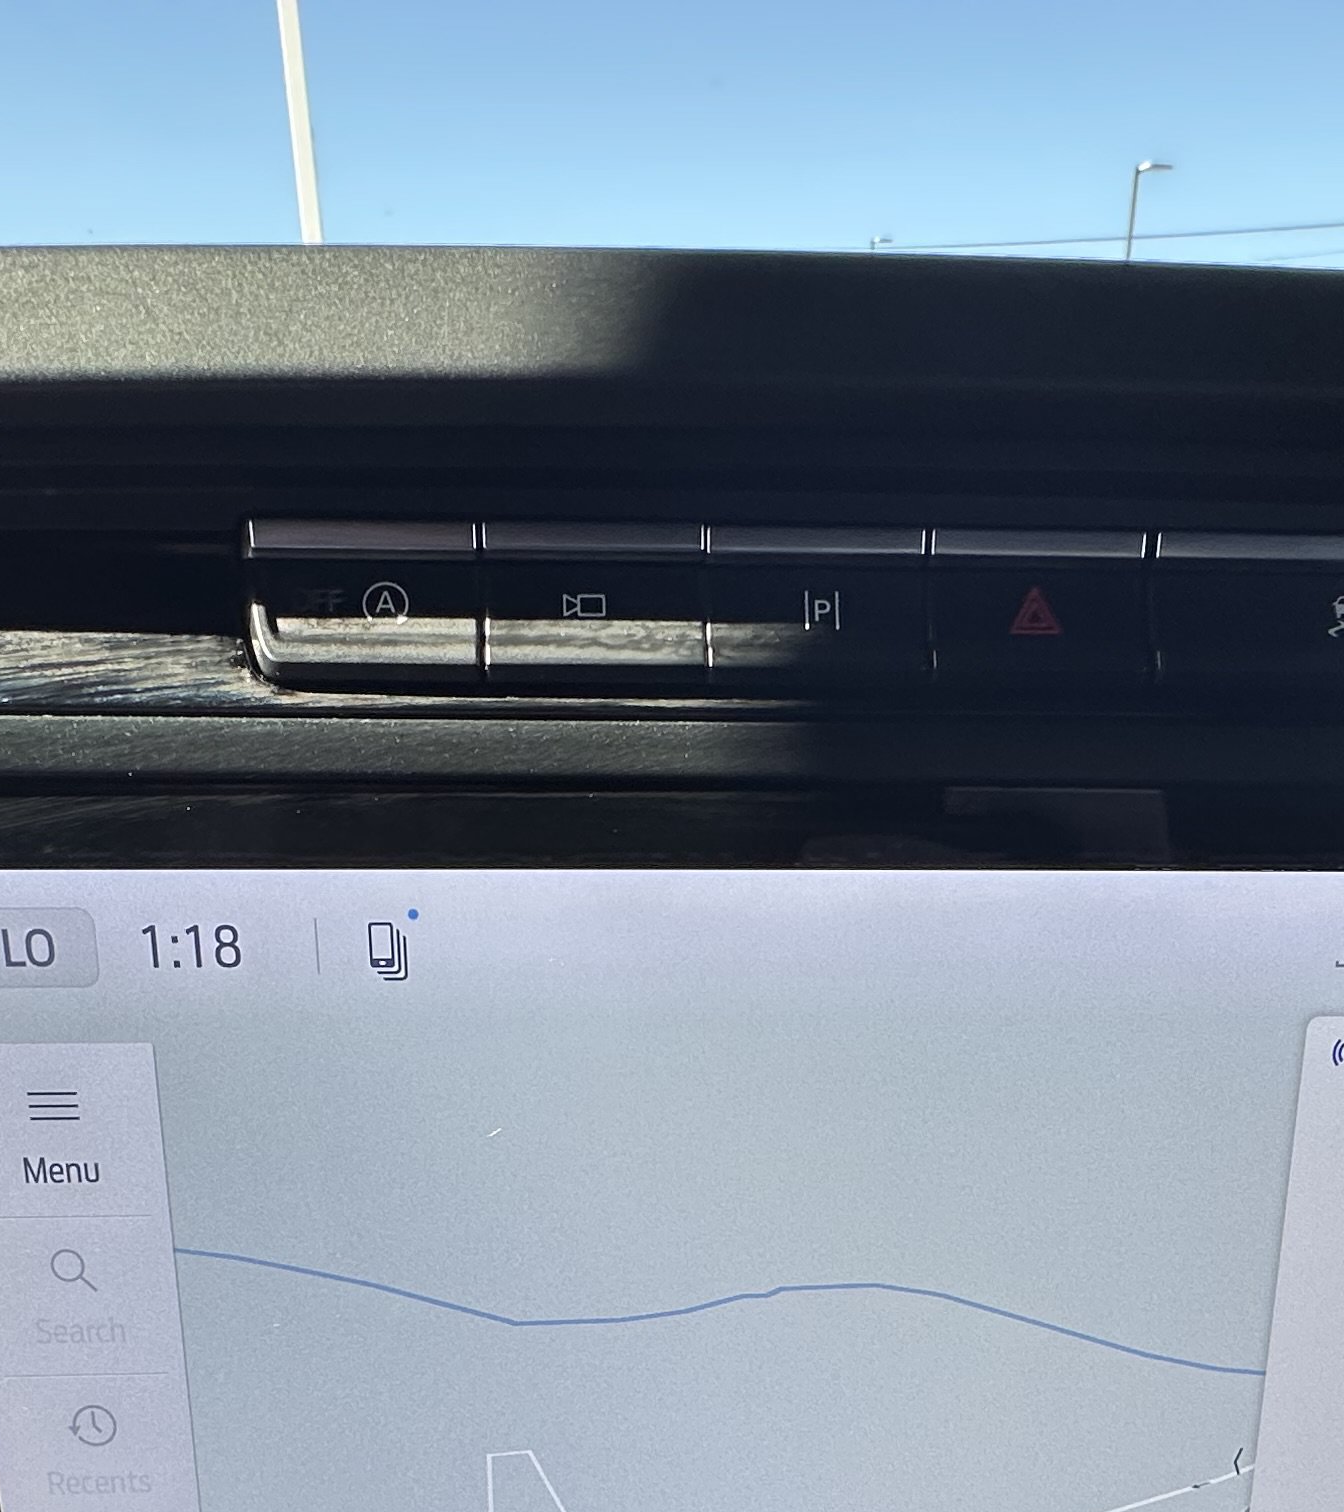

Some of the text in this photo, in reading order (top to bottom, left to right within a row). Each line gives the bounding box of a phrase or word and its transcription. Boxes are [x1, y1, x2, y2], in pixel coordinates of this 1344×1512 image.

[814, 600, 831, 621] P
[0, 924, 242, 969] LO 1:18
[23, 1156, 100, 1184] Menu
[36, 1318, 127, 1344] Search
[47, 1470, 152, 1496] Recents
